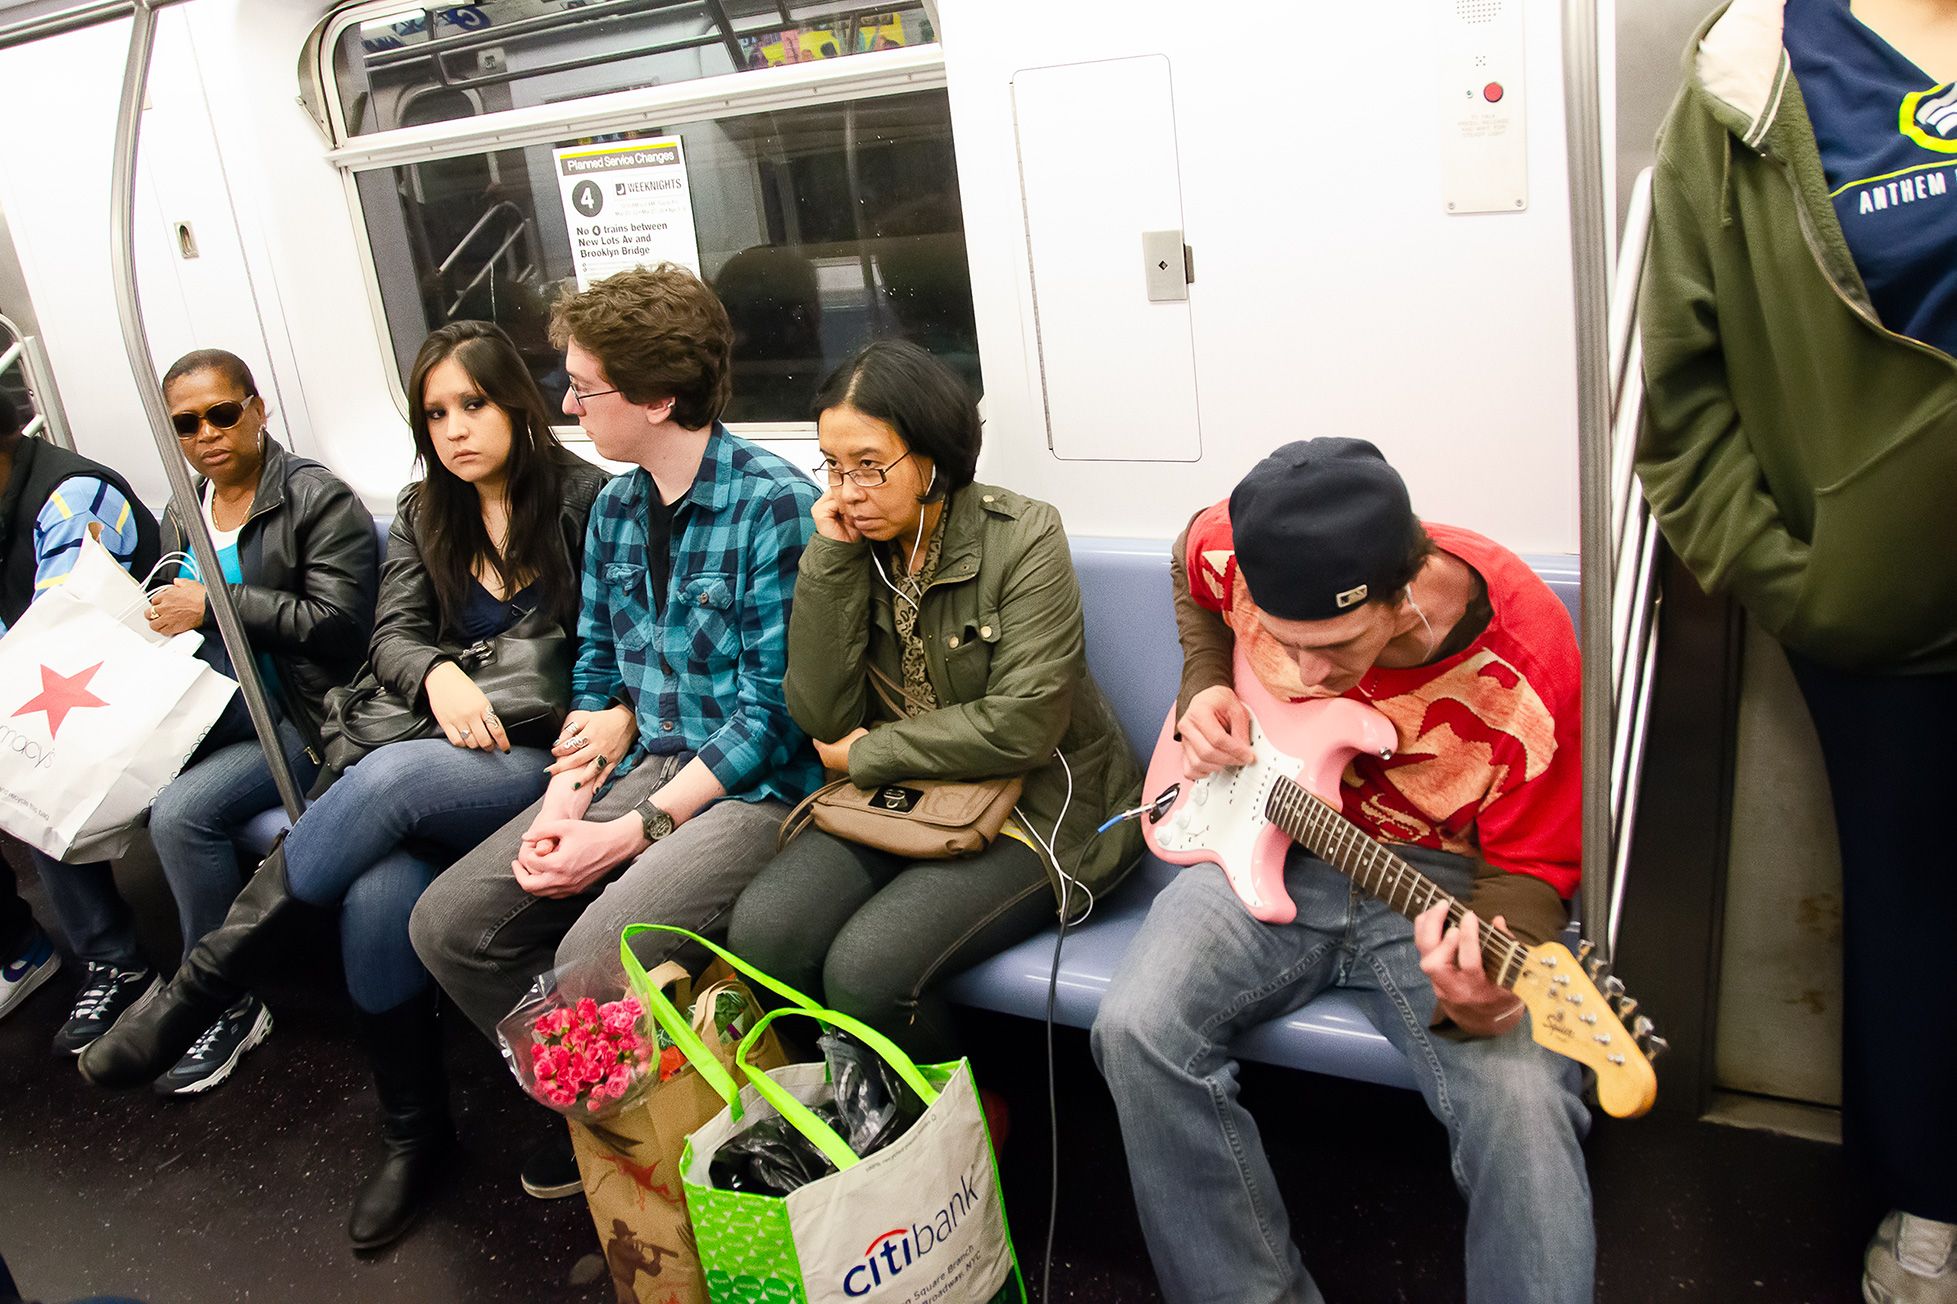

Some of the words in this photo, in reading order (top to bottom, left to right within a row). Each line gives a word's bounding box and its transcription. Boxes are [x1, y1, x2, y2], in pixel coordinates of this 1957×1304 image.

[568, 158, 603, 171] Planned
[604, 155, 634, 167] Service
[635, 151, 674, 164] Changes
[627, 178, 682, 193] WEEKNIGHTS
[1860, 172, 1946, 214] ANTHEM
[576, 226, 589, 235] No
[604, 224, 628, 233] trains
[631, 222, 668, 231] between
[578, 238, 599, 247] New
[601, 236, 620, 245] Lots
[622, 235, 633, 244] Av
[635, 233, 651, 243] and
[580, 248, 619, 258] Brooklyn
[622, 245, 650, 256] Bridge
[843, 1174, 979, 1298] citibank
[913, 1272, 945, 1301] Square
[947, 1245, 975, 1273] Branch
